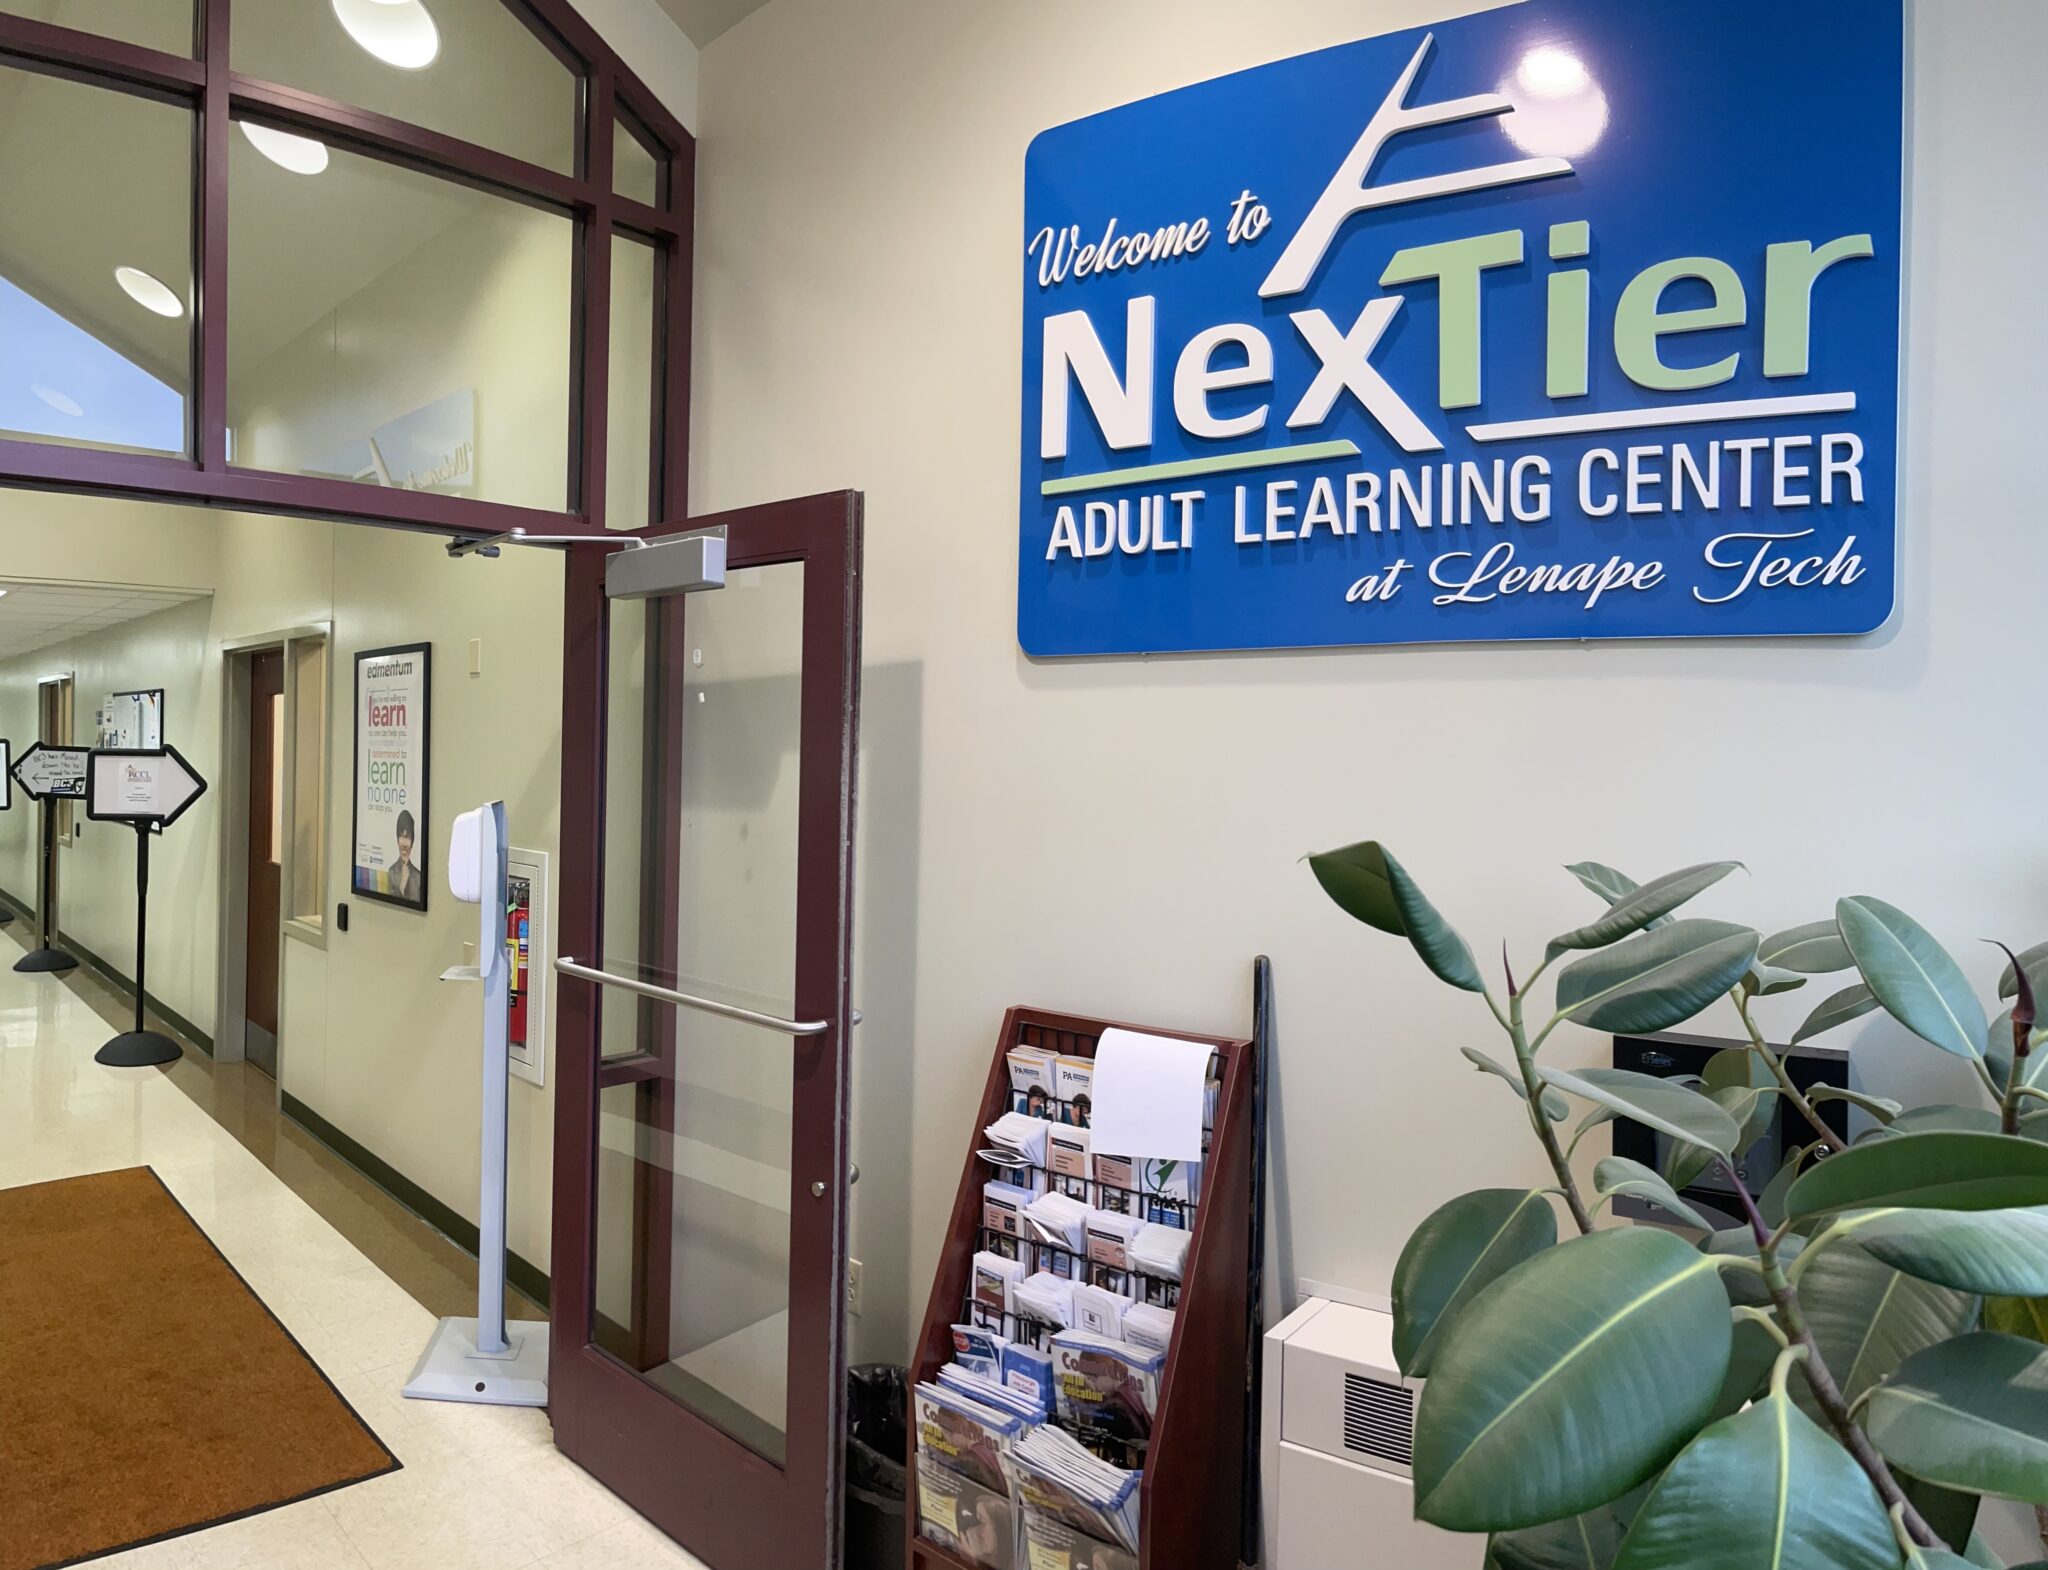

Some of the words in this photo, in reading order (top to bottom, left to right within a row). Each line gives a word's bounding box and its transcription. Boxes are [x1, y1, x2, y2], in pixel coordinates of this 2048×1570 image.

[1028, 214, 1211, 288] Welcome
[1225, 189, 1272, 245] to
[1046, 490, 1205, 561] ADULT
[1234, 455, 1553, 545] LEARNING
[1578, 432, 1866, 516] CENTER
[1346, 559, 1414, 604] at
[1428, 541, 1666, 610] Lenape
[1693, 528, 1868, 604] Tech
[367, 660, 412, 679] edmentum
[367, 786, 381, 803] no
[383, 787, 407, 806] one
[1014, 1066, 1024, 1075] PA
[1063, 1071, 1073, 1081] PA
